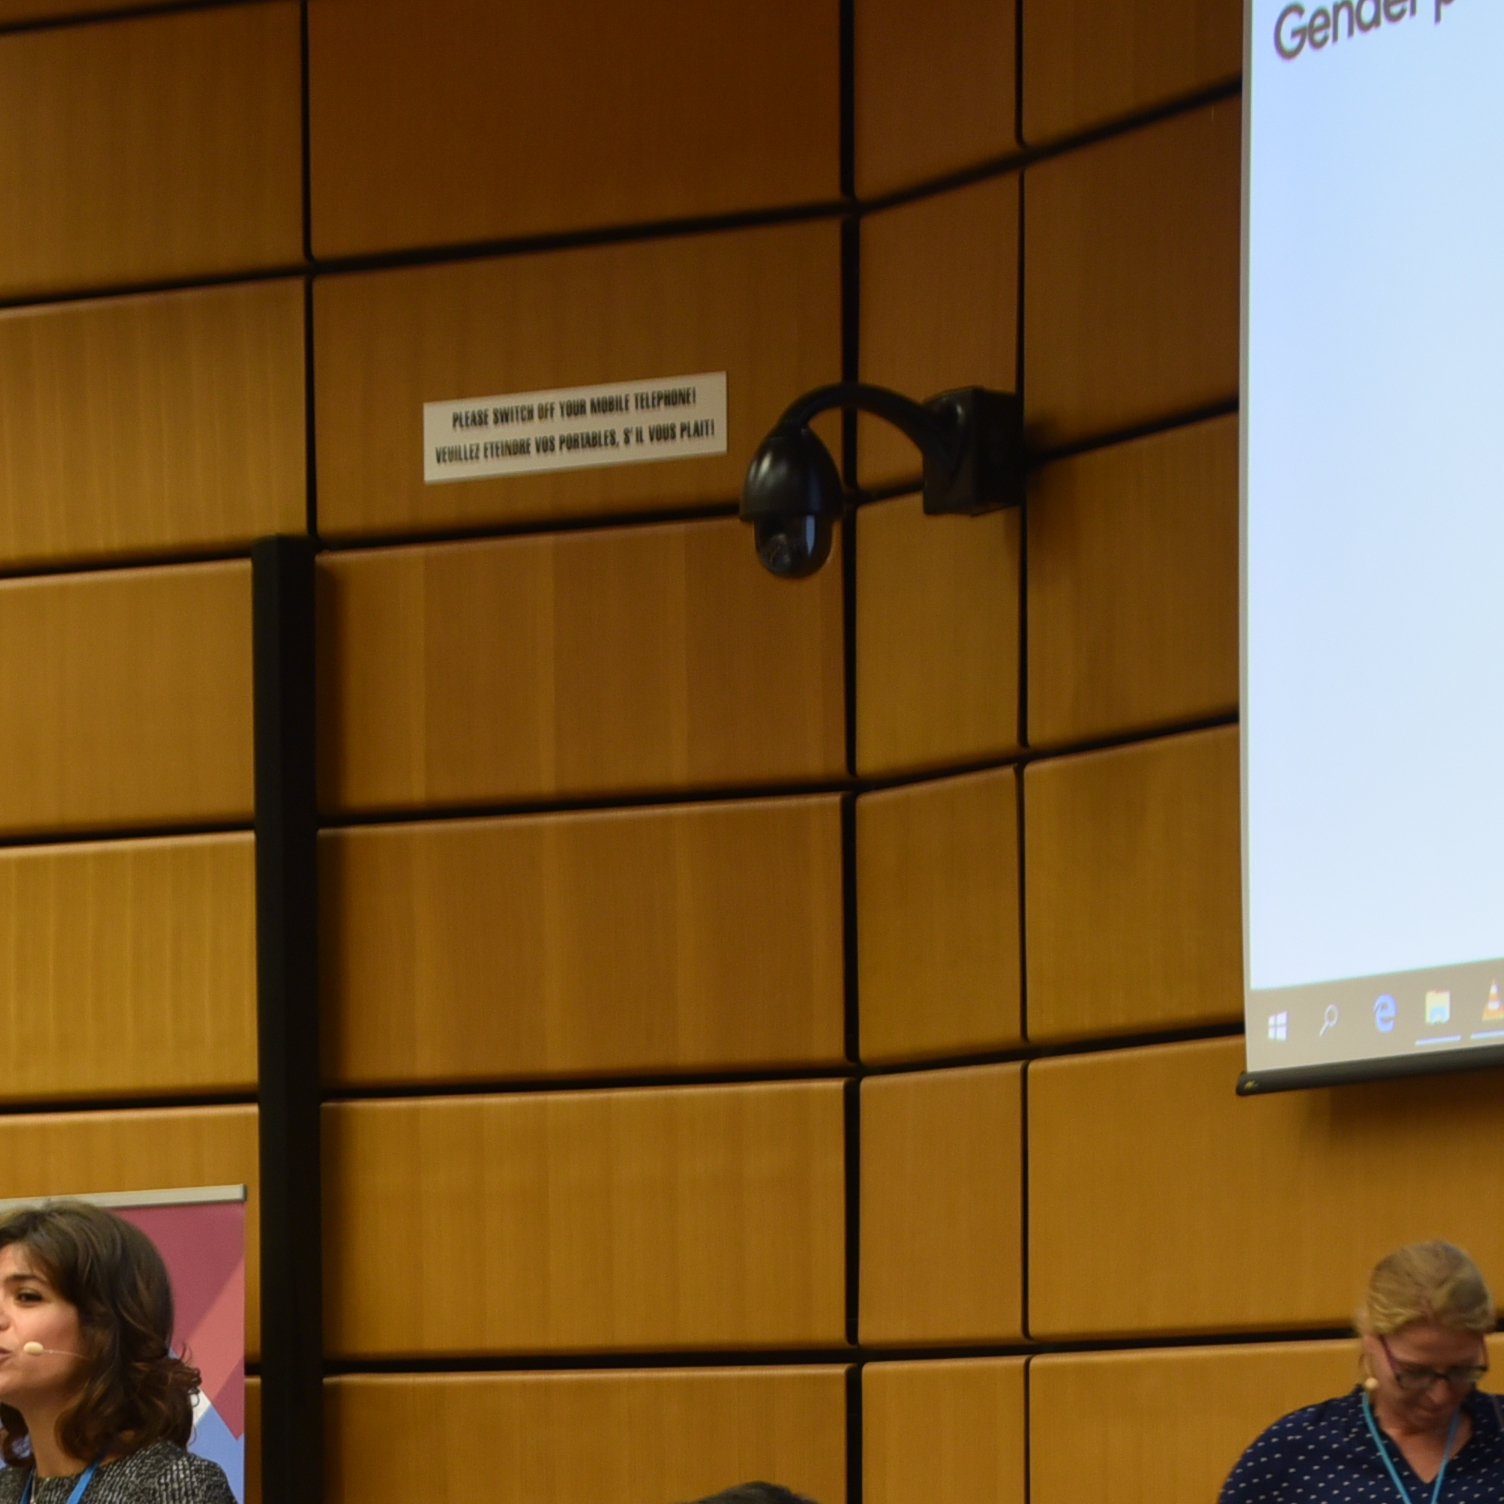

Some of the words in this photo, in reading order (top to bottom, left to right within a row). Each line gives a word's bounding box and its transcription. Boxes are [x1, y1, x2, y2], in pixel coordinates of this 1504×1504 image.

[452, 408, 489, 429] PLEASE
[492, 403, 534, 425] SWITCH
[537, 401, 556, 421] OFF
[559, 398, 587, 418] YOUR
[590, 393, 630, 414] MOBILE
[634, 386, 696, 410] TELEPHONE!
[435, 442, 481, 464] VEUILLEZ
[483, 437, 532, 458] ETEINDRE
[534, 434, 556, 453] VOS
[559, 427, 620, 451] PORTABLES,
[648, 421, 677, 442] VOUS
